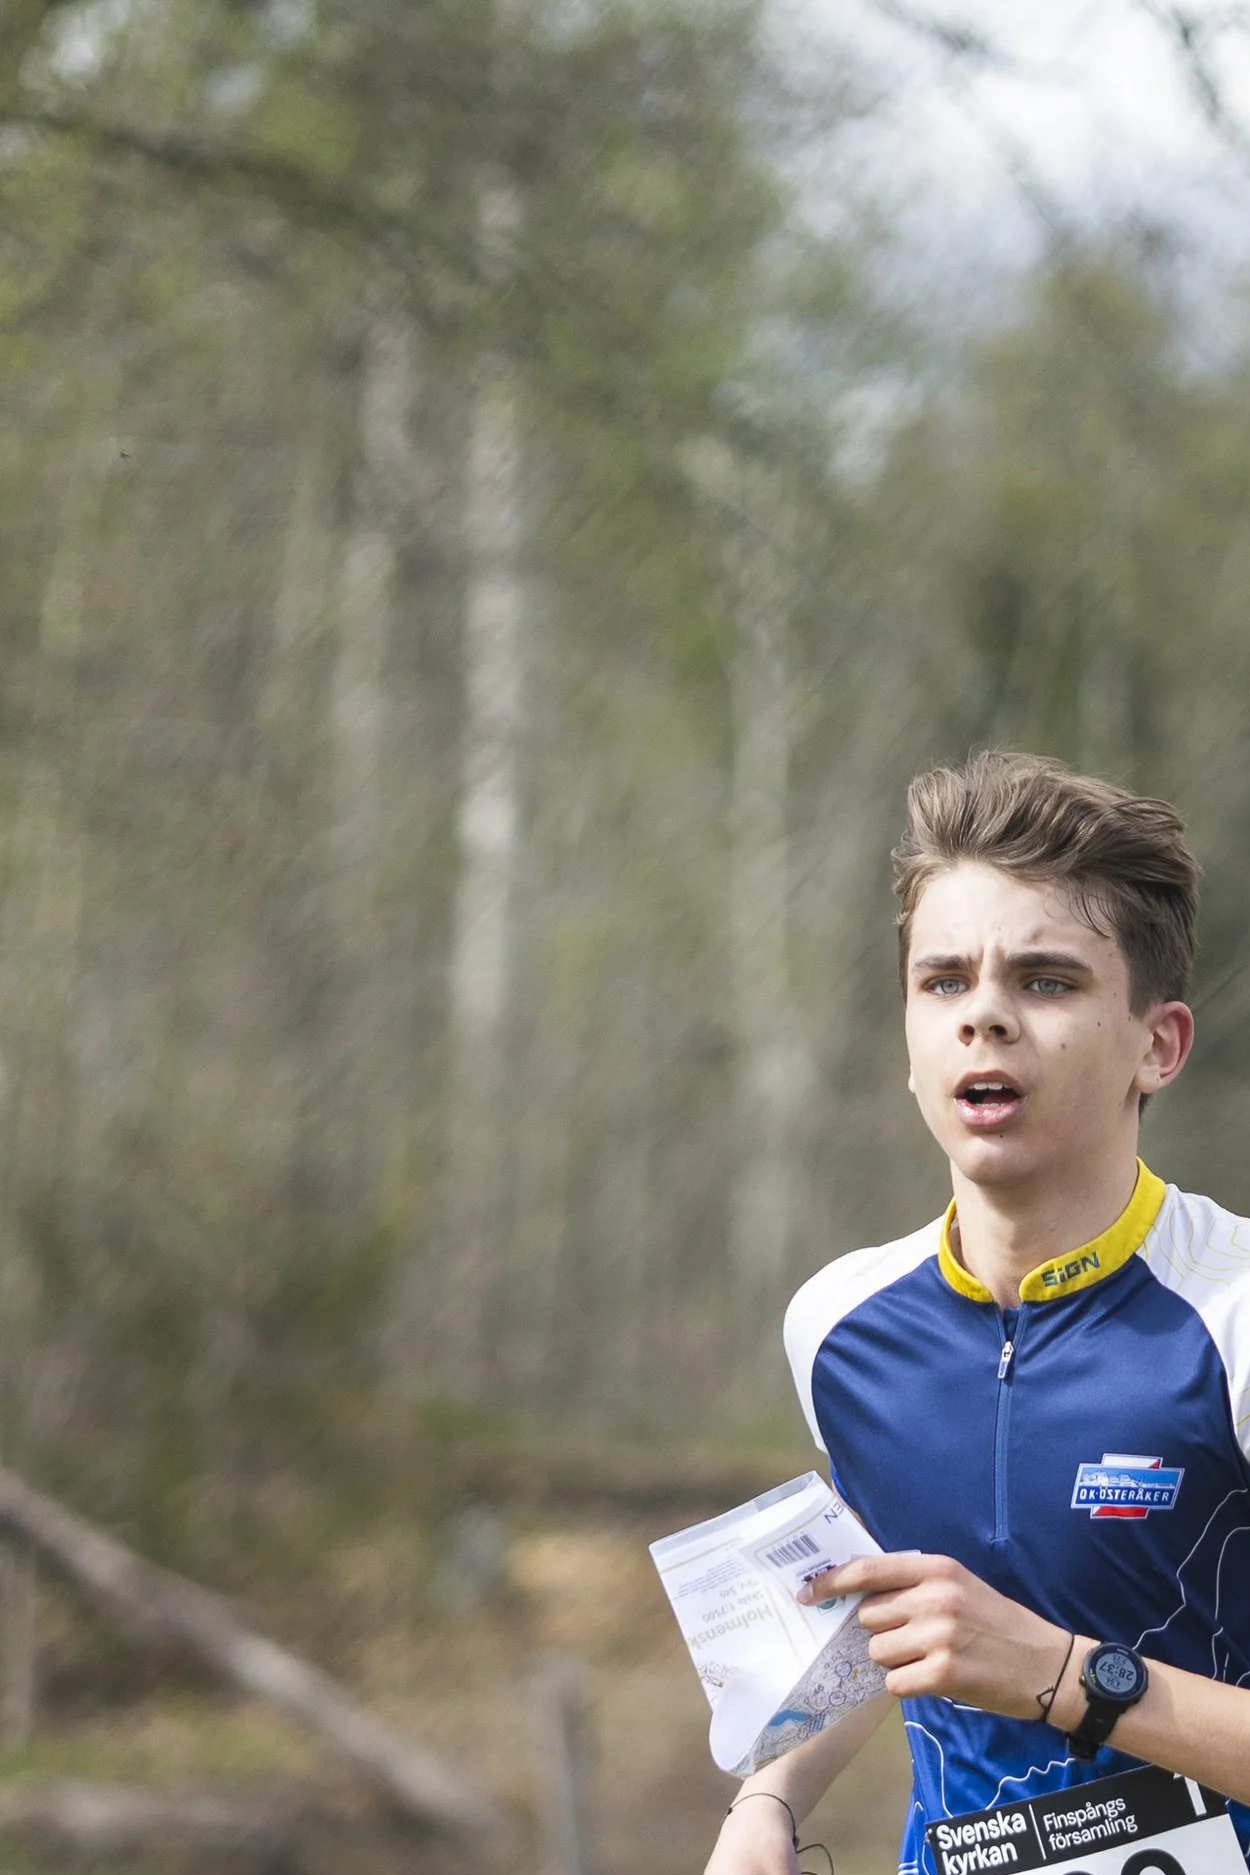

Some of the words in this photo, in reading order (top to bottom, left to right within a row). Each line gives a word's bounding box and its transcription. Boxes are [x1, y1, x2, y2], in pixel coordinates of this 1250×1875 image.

[1099, 1661, 1134, 1681] 28:37
[938, 1811, 1027, 1851] Svenska
[1043, 1797, 1126, 1832] Finspångs
[1048, 1811, 1138, 1851] församling
